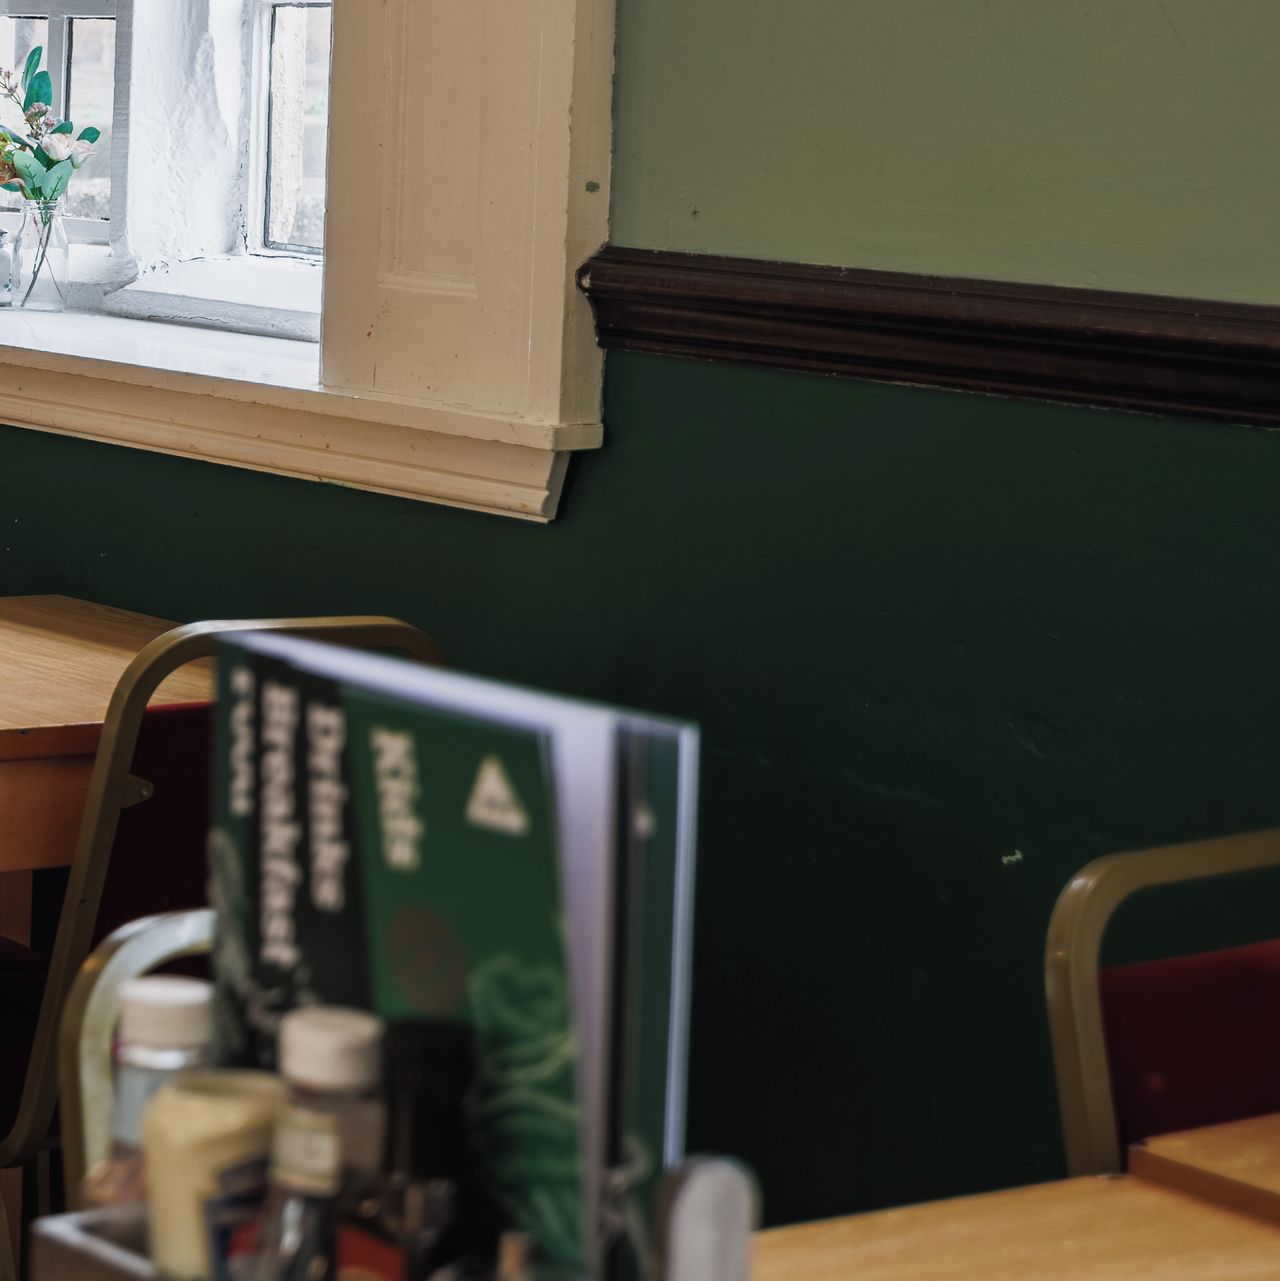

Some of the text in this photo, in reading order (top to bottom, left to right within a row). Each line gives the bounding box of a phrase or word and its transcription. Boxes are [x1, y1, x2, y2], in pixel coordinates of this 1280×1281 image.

[261, 682, 300, 968] Breakfast
[306, 702, 348, 912] Drinks
[370, 726, 424, 872] Kids
